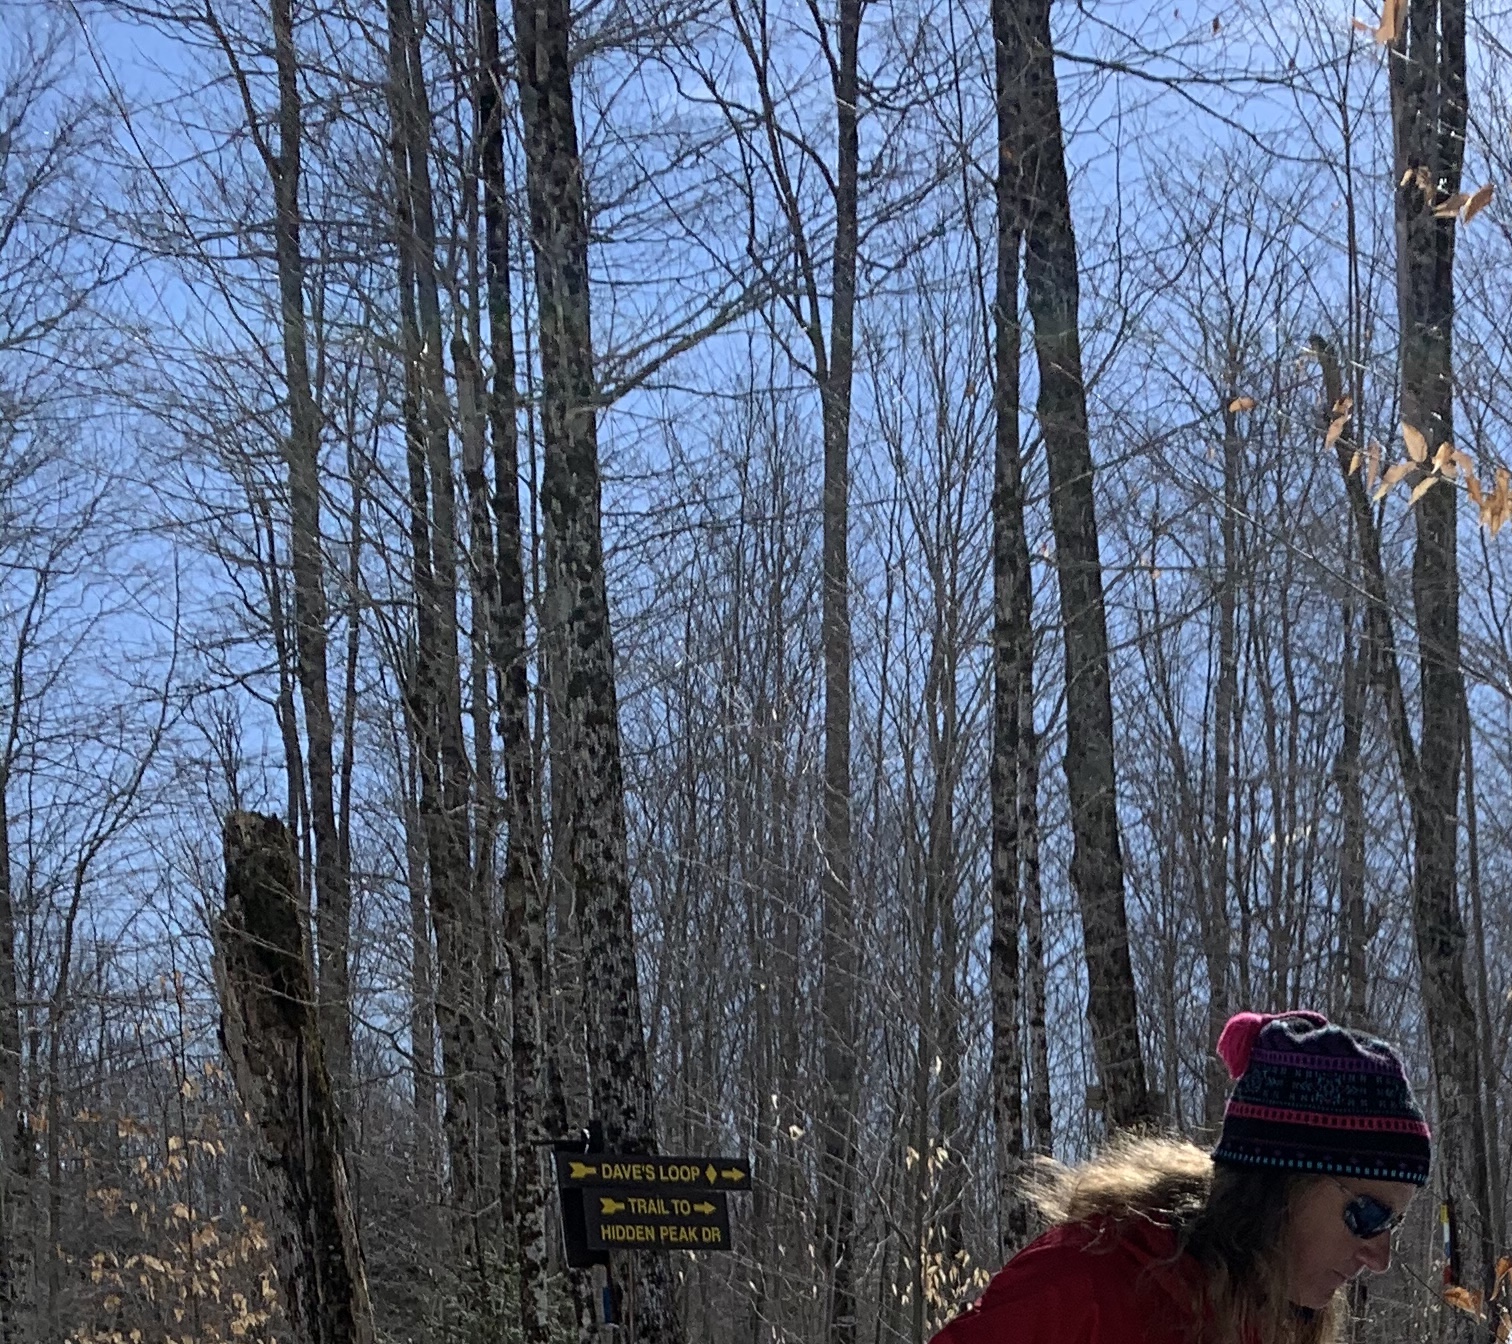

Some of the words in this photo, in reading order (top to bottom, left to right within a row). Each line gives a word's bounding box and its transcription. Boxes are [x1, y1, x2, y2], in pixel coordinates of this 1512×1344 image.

[601, 1163, 655, 1181] DAVE'S
[659, 1164, 700, 1182] LOOP
[628, 1197, 670, 1215] TRAIL
[671, 1198, 691, 1215] TO
[601, 1223, 655, 1241] HIDDEN
[659, 1225, 698, 1242] PEAK
[702, 1226, 722, 1242] DR
